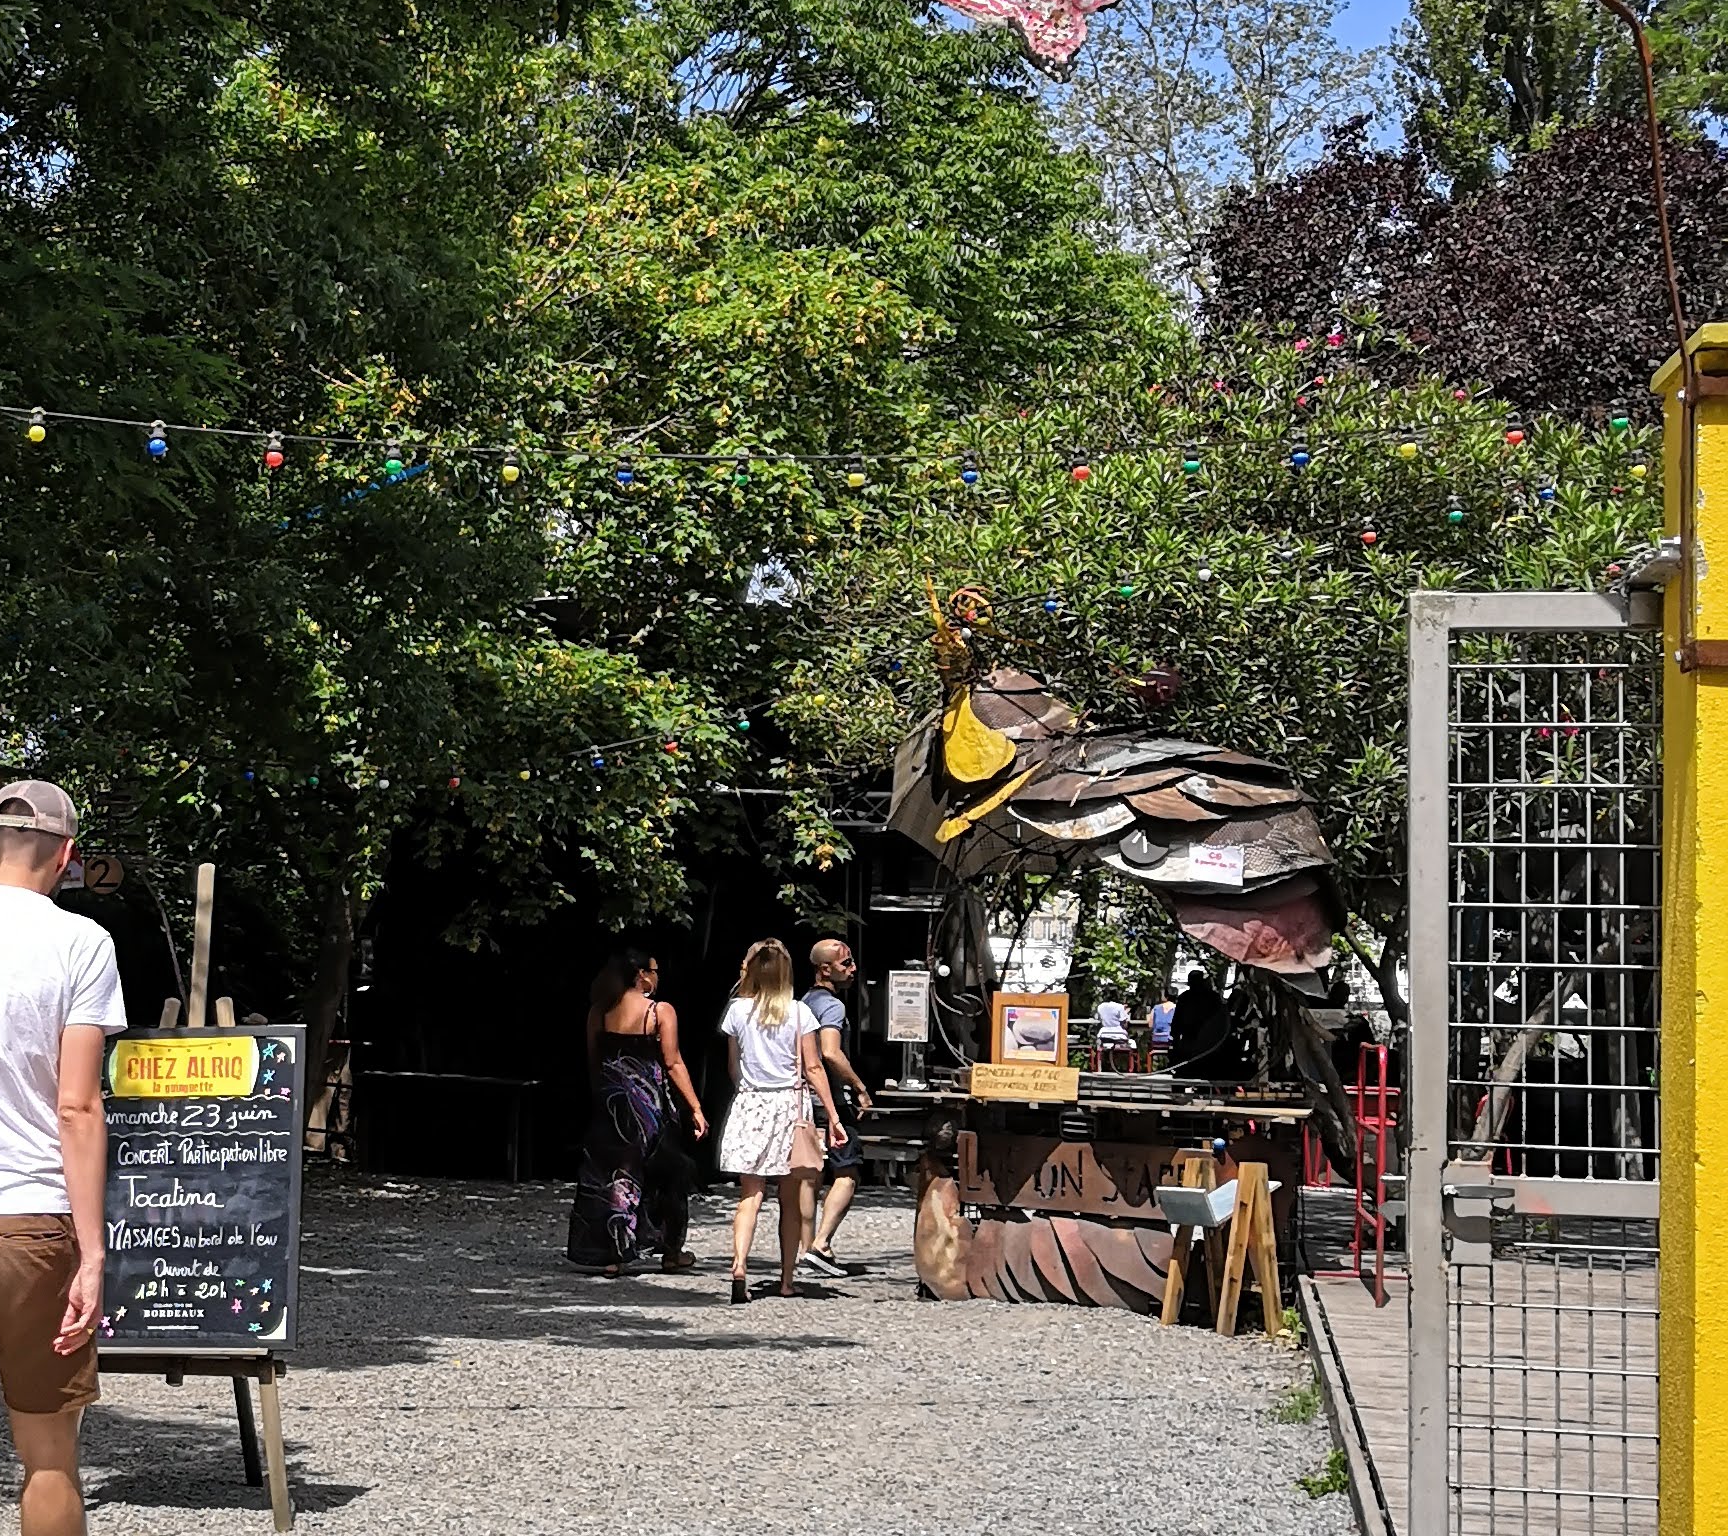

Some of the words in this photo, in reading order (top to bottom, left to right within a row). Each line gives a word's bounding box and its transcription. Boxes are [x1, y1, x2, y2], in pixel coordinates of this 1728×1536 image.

[90, 860, 119, 888] 2
[127, 1057, 177, 1080] CHEZ
[186, 1056, 243, 1080] ALRIQ
[152, 1082, 161, 1093] la
[165, 1082, 214, 1094] guinguette
[106, 1102, 179, 1125] imanche
[181, 1104, 221, 1127] 23
[225, 1105, 278, 1129] juin
[118, 1175, 225, 1208] Tocatina
[197, 1226, 223, 1249] bord
[226, 1225, 245, 1246] de
[152, 1257, 203, 1278] Ouvert
[202, 1259, 222, 1278] de
[194, 1280, 227, 1300] 20h
[143, 1308, 205, 1319] BORDEAUX
